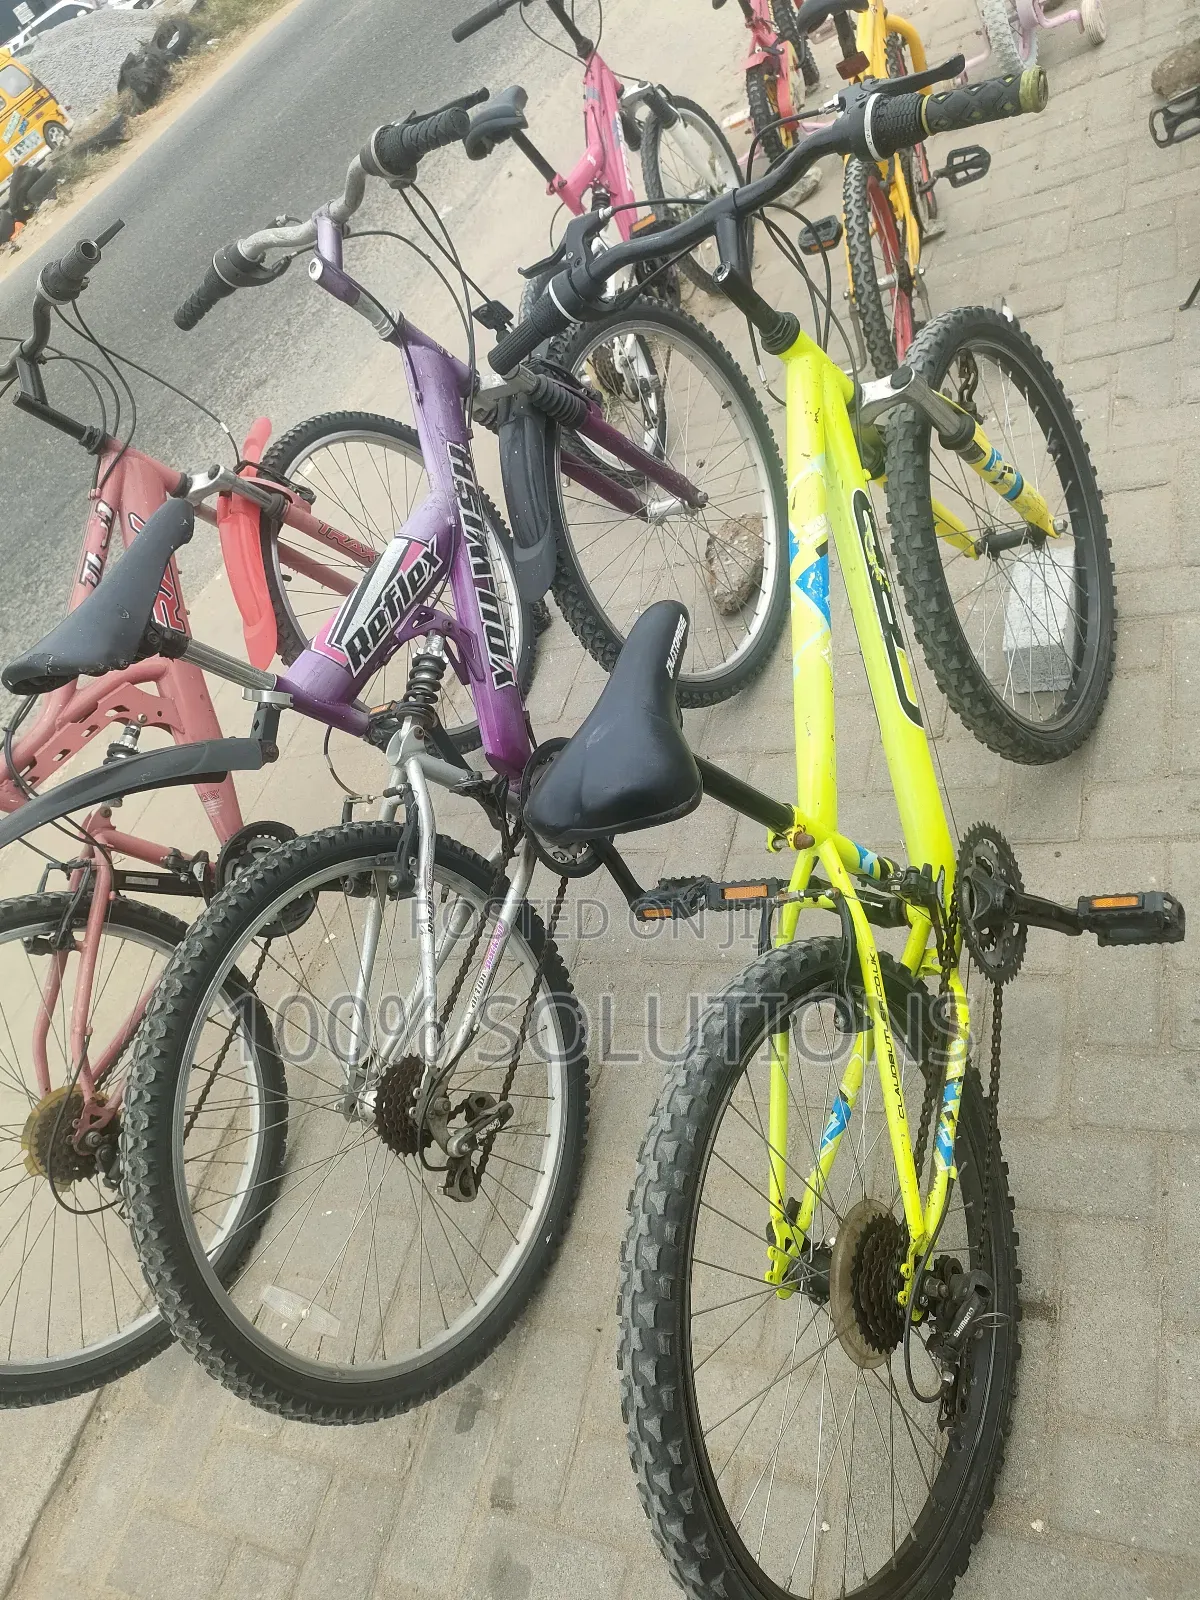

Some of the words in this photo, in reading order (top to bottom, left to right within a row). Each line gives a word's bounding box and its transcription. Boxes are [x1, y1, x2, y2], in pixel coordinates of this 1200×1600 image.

[318, 520, 381, 563] TRAX
[446, 441, 495, 579] WISH
[343, 534, 443, 678] Reflex
[476, 587, 518, 690] YOU
[871, 953, 905, 1119] CLAUDBUTLER.CO.UK
[953, 1307, 975, 1338] SHIMANO
